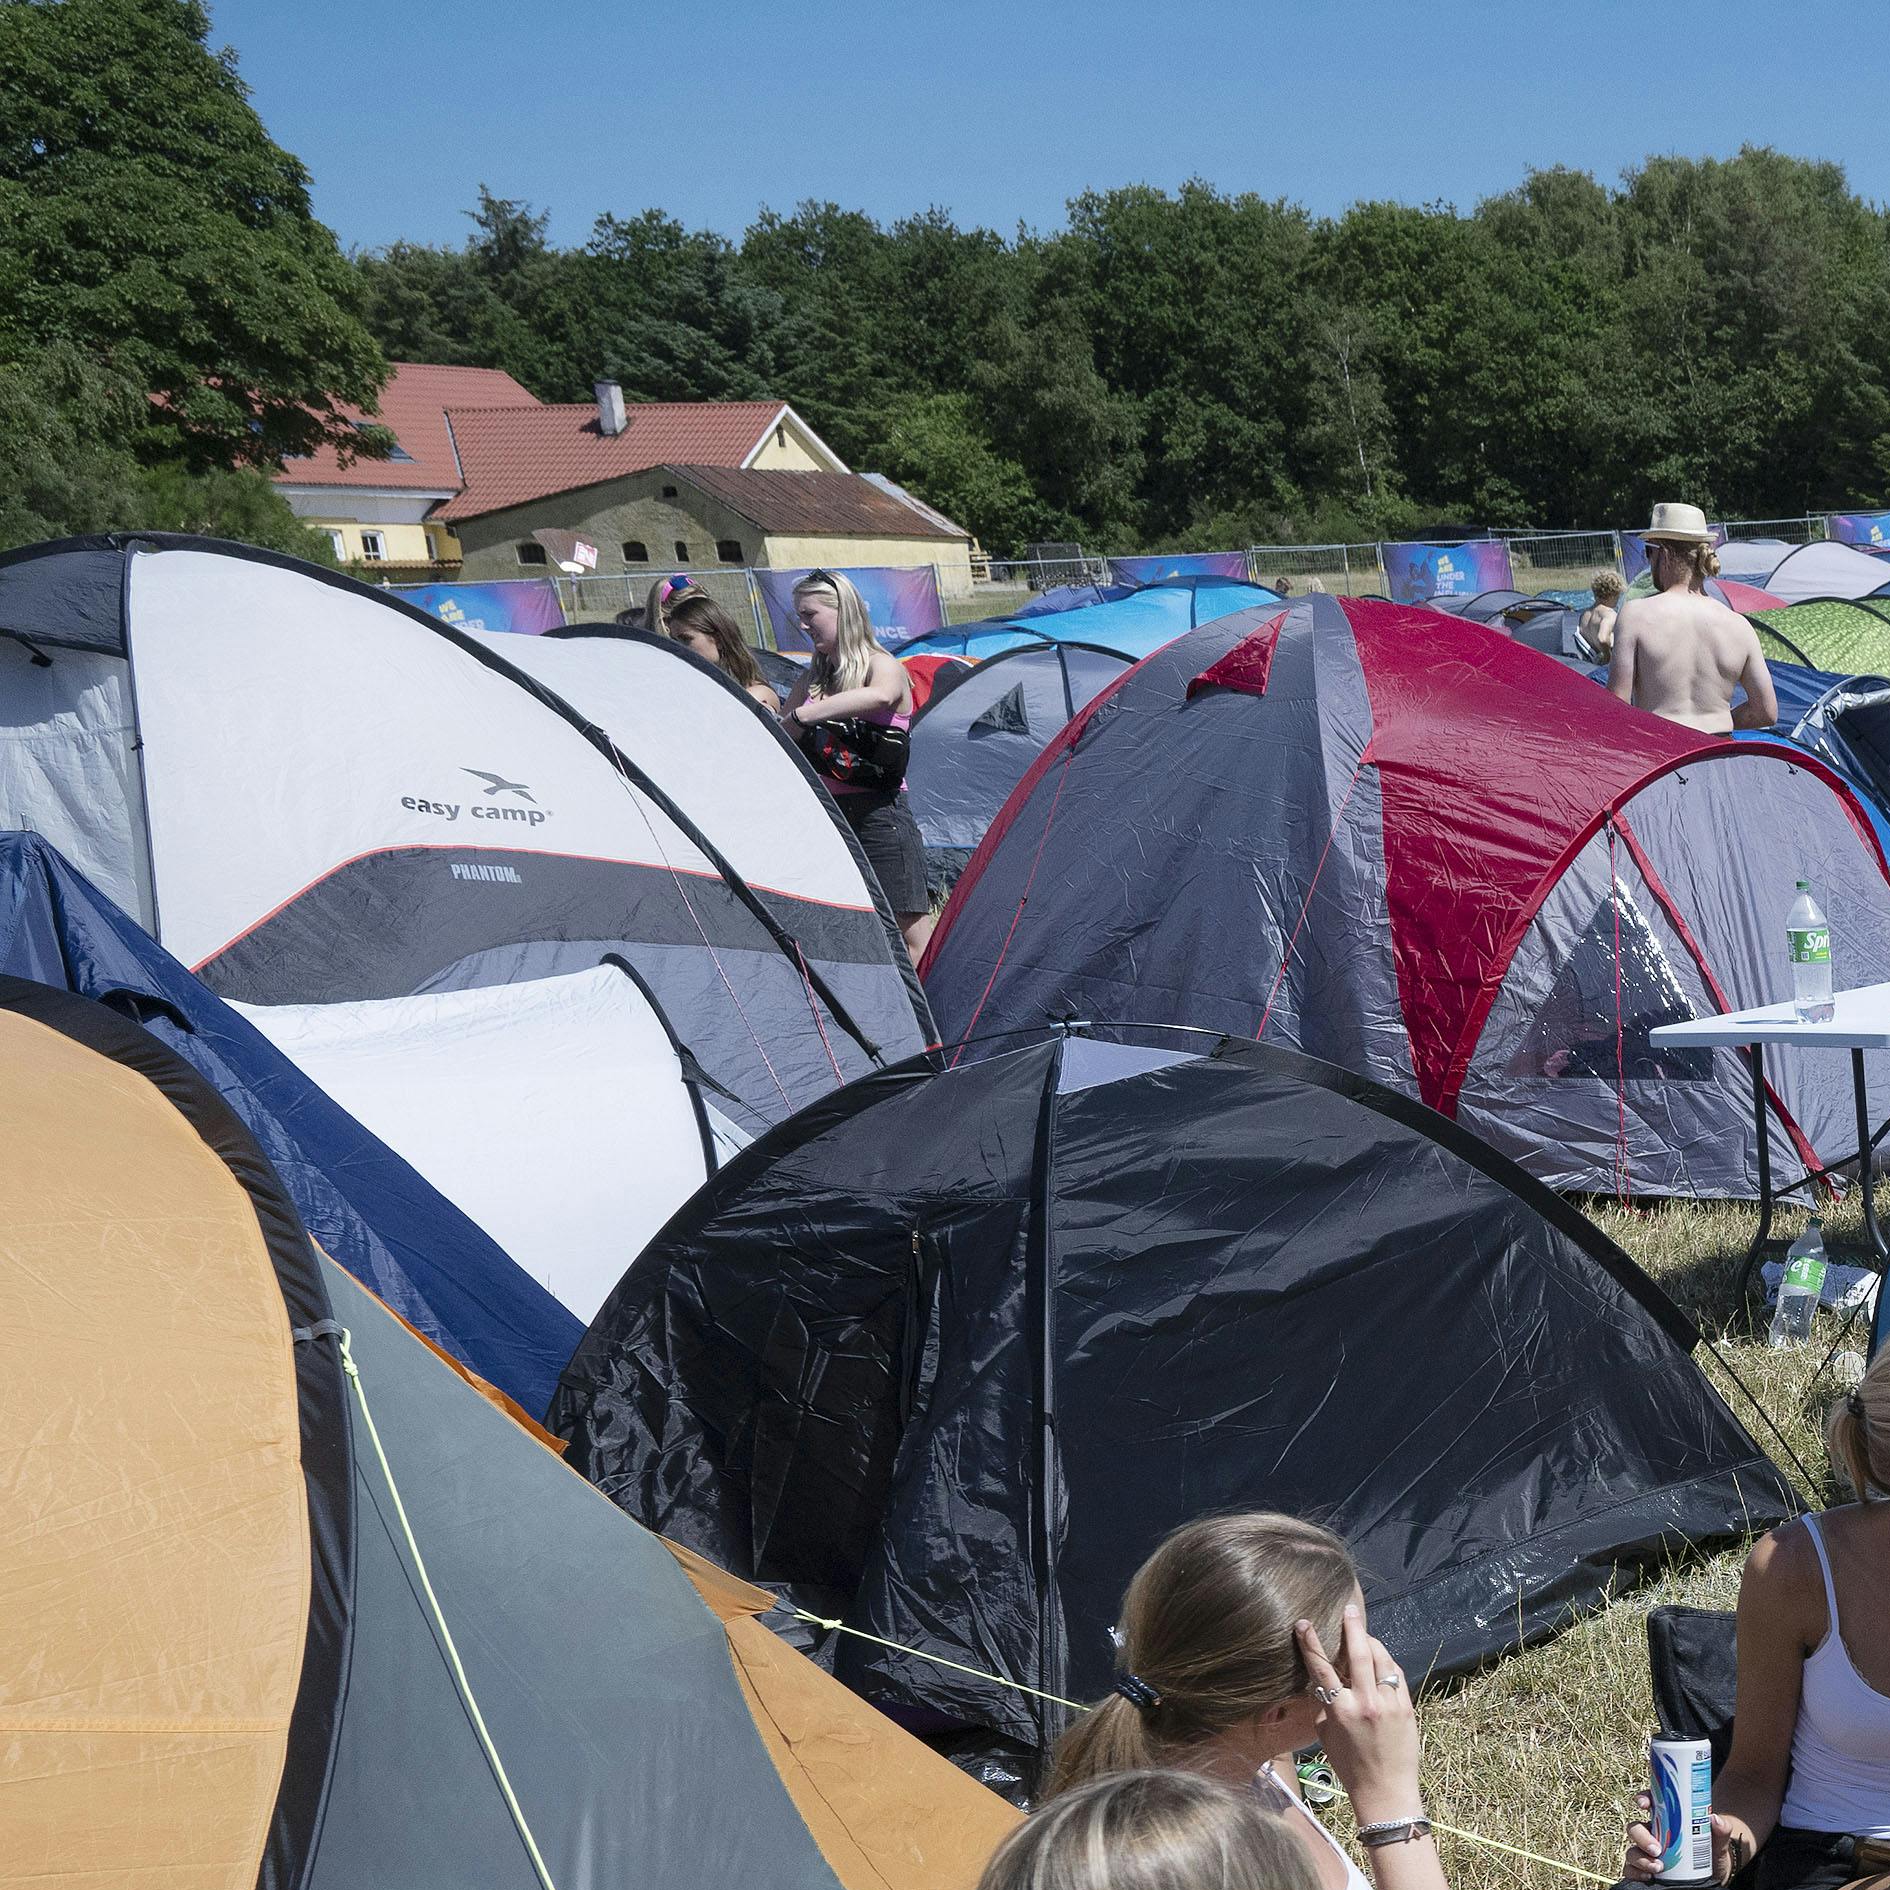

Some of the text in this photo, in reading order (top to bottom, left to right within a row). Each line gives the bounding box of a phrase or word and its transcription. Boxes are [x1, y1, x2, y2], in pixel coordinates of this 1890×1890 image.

[401, 796, 546, 827] easy camp
[450, 864, 517, 884] PHANTOM
